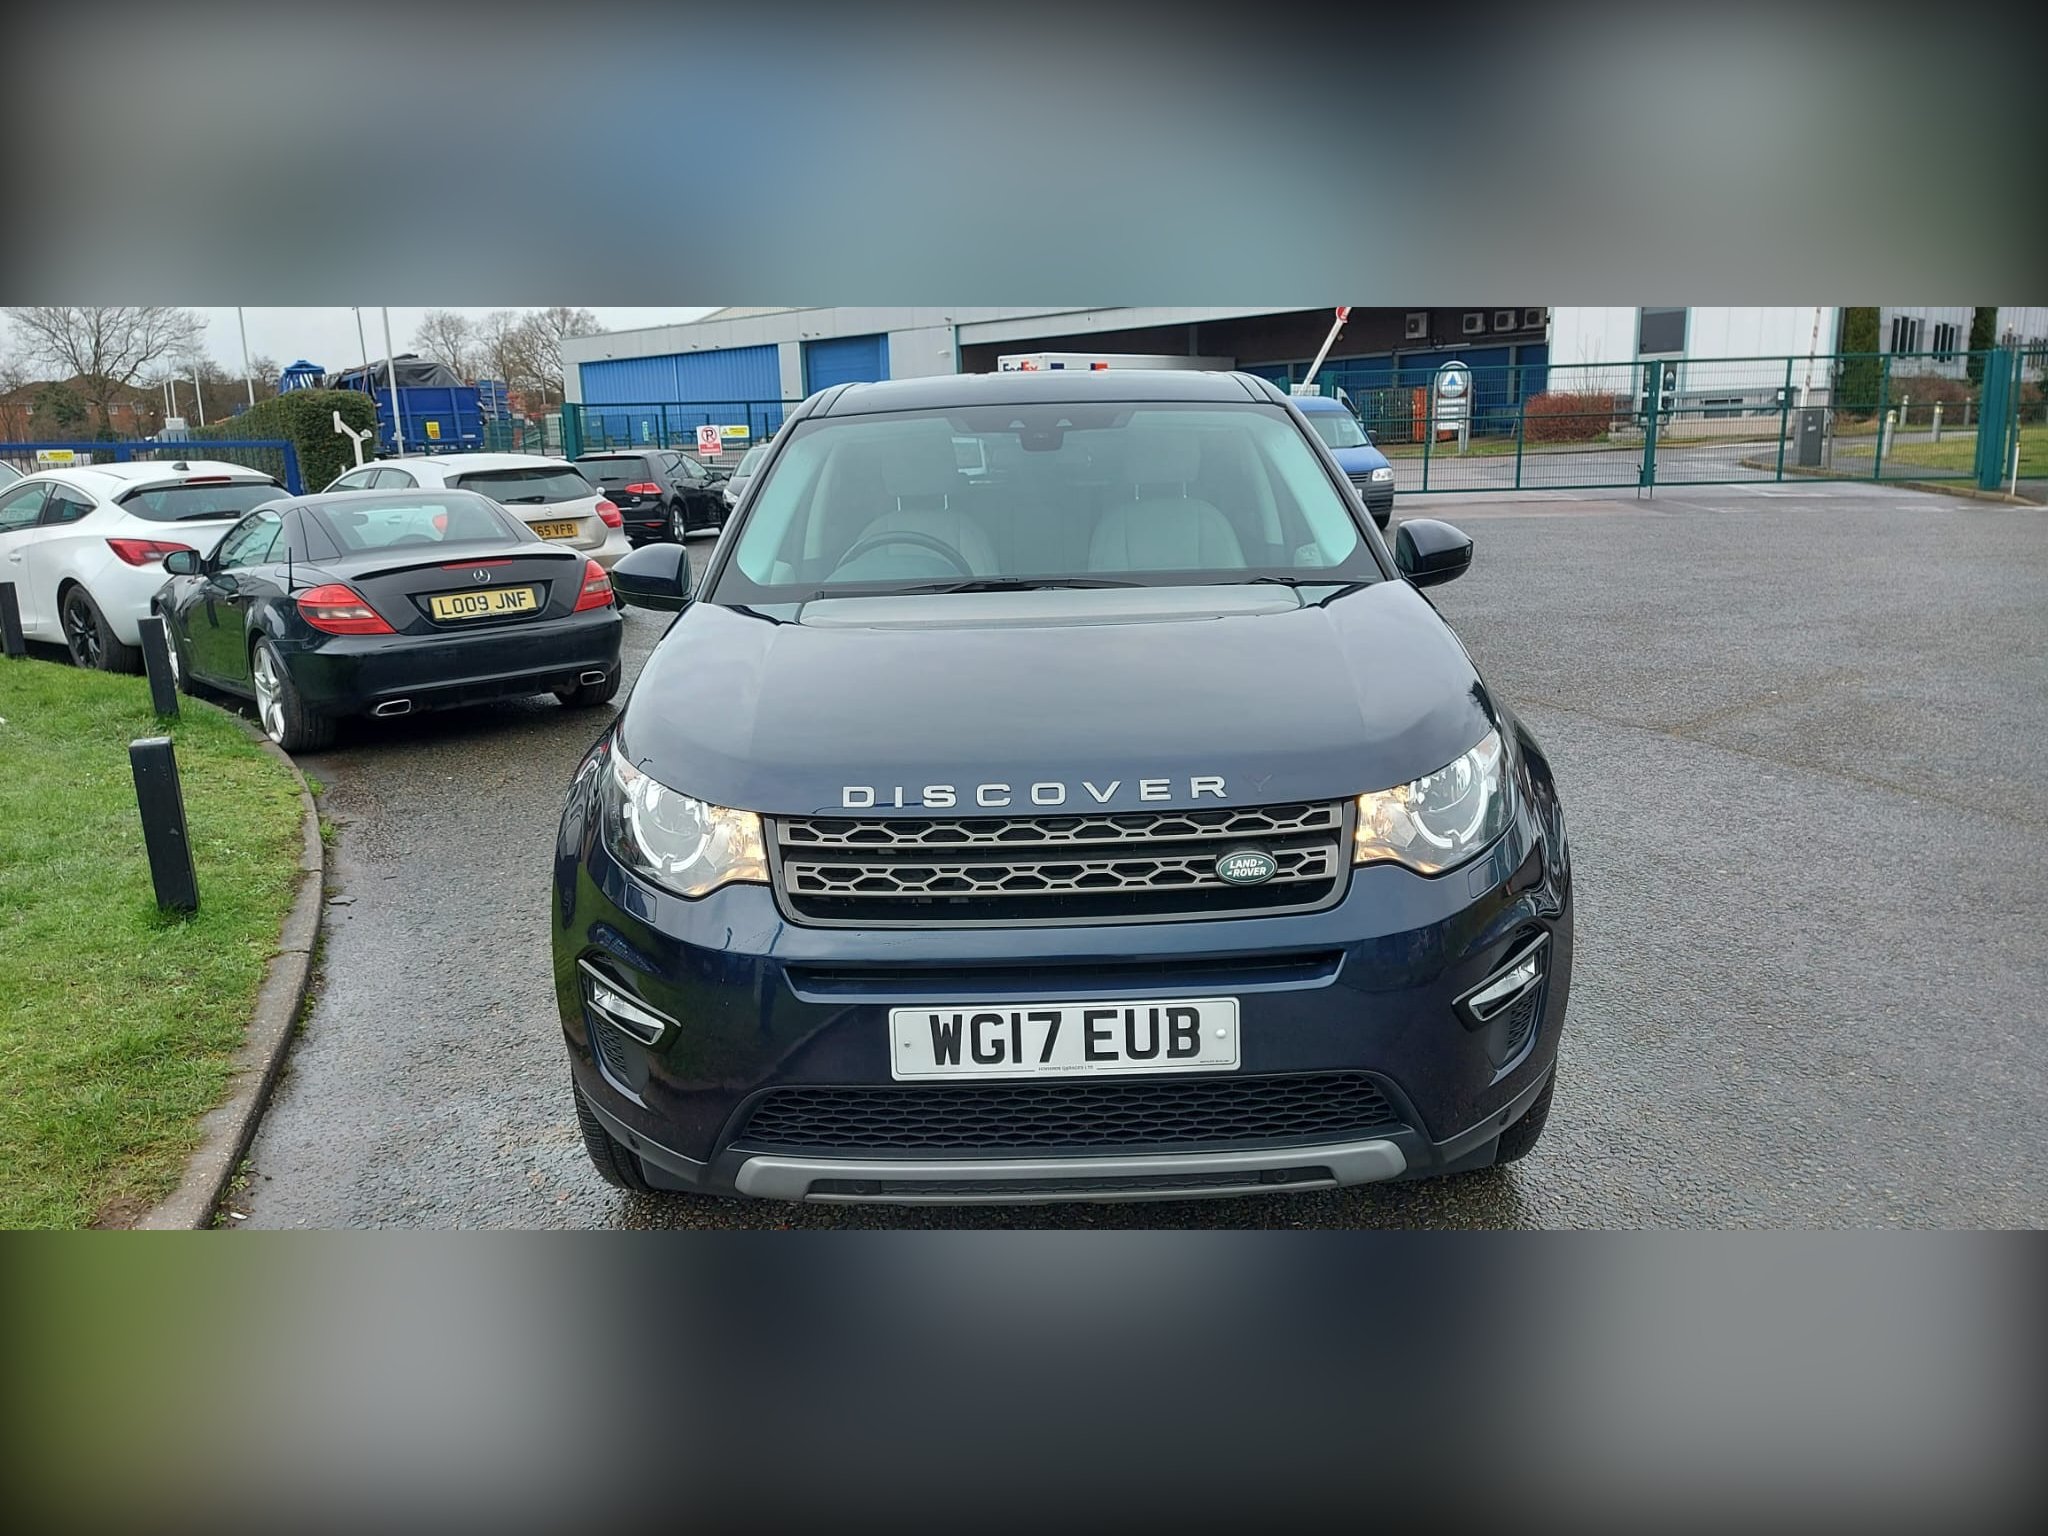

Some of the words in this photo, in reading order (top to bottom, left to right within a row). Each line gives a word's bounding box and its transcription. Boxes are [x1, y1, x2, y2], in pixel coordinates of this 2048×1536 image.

[439, 595, 489, 615] LO09
[496, 591, 527, 609] JNF
[842, 776, 1228, 808] DISCOVER
[1229, 859, 1258, 869] LAND
[1233, 867, 1267, 877] ROVER
[929, 1011, 1062, 1066] WG17
[1083, 1007, 1201, 1062] EUB
